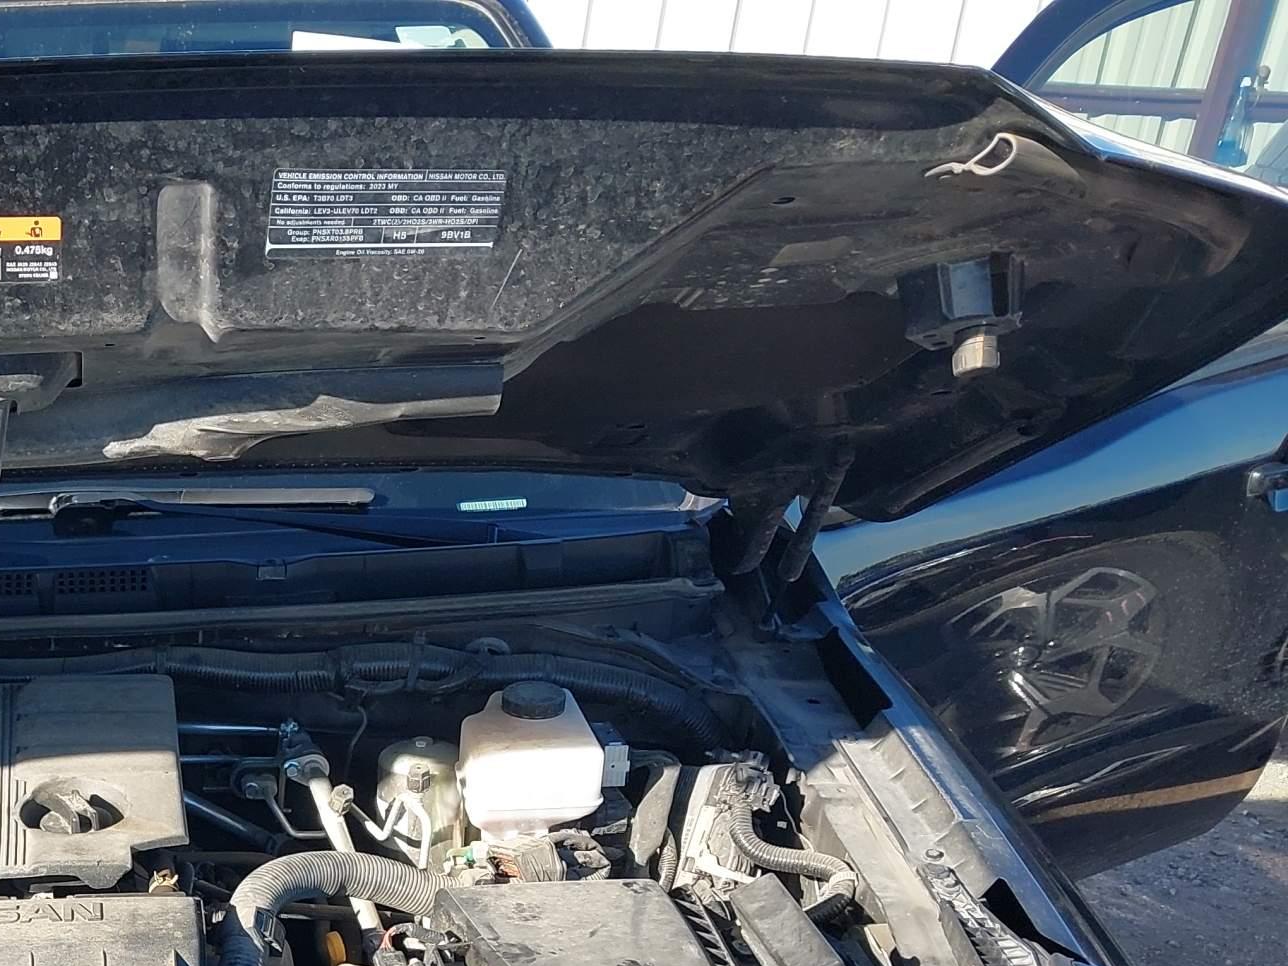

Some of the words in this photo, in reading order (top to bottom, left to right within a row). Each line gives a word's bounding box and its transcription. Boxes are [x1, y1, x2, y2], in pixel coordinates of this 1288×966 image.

[278, 172, 307, 180] VEHICLE
[309, 172, 342, 180] EMISSION
[277, 182, 312, 190] Conforms
[323, 183, 366, 191] regulations:
[292, 194, 310, 202] EPA:
[274, 207, 311, 215] California:
[389, 207, 408, 215] OBD:
[469, 207, 498, 215] Gasoline
